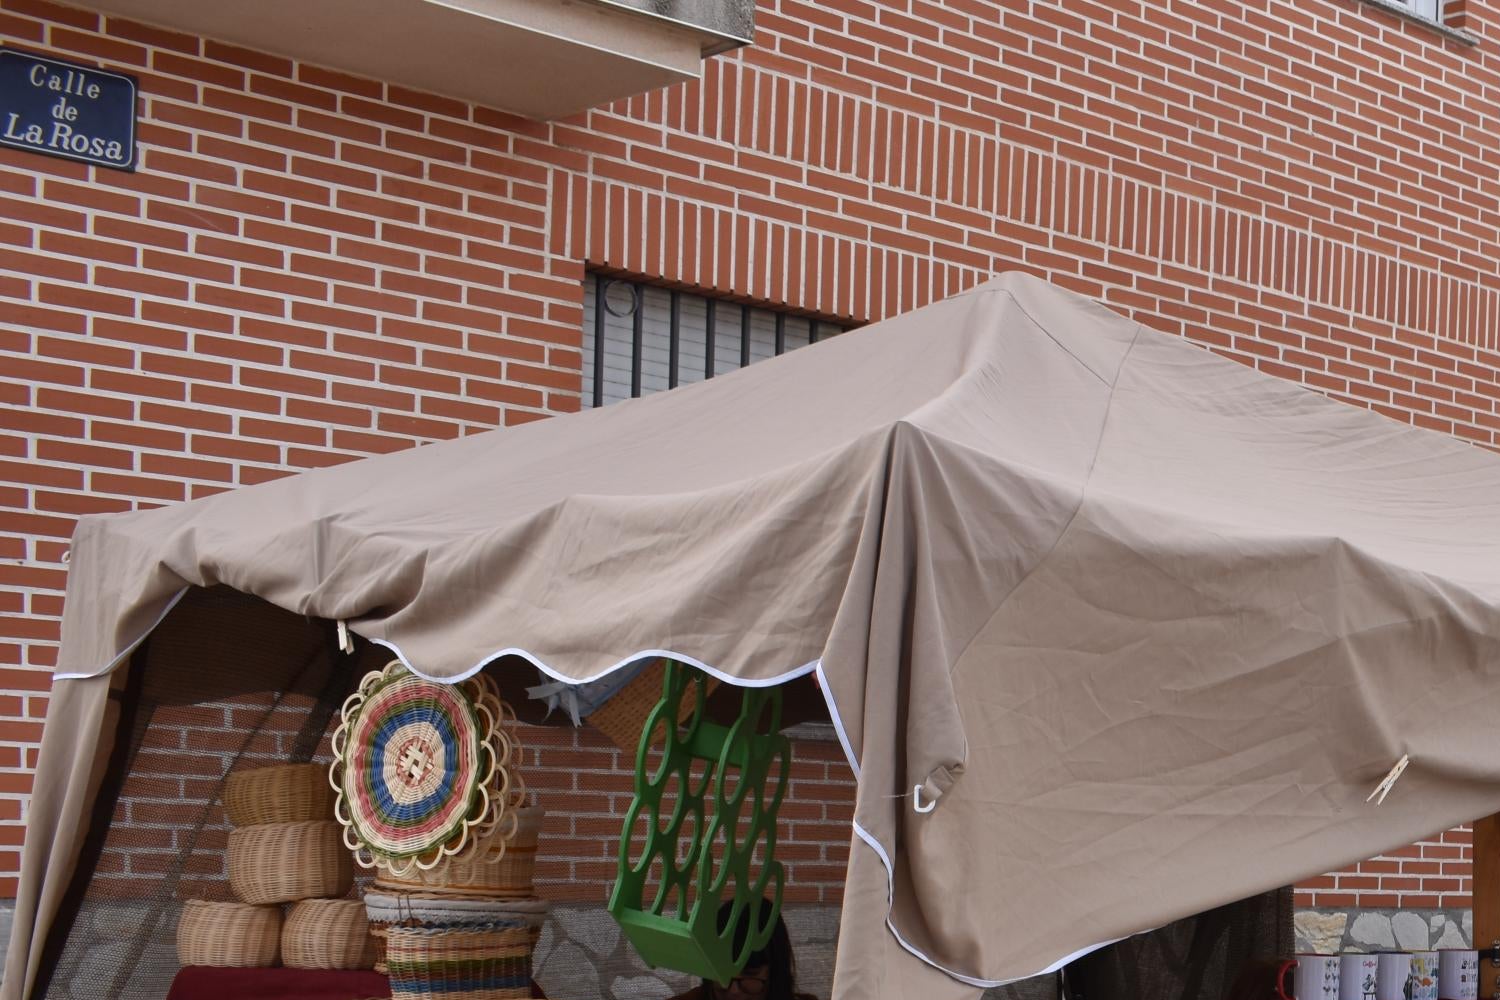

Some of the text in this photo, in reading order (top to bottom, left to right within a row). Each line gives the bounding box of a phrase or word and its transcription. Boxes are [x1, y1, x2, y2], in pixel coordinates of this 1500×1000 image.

[30, 64, 101, 99] Calle
[52, 97, 78, 121] de
[4, 112, 123, 160] La Rosa
